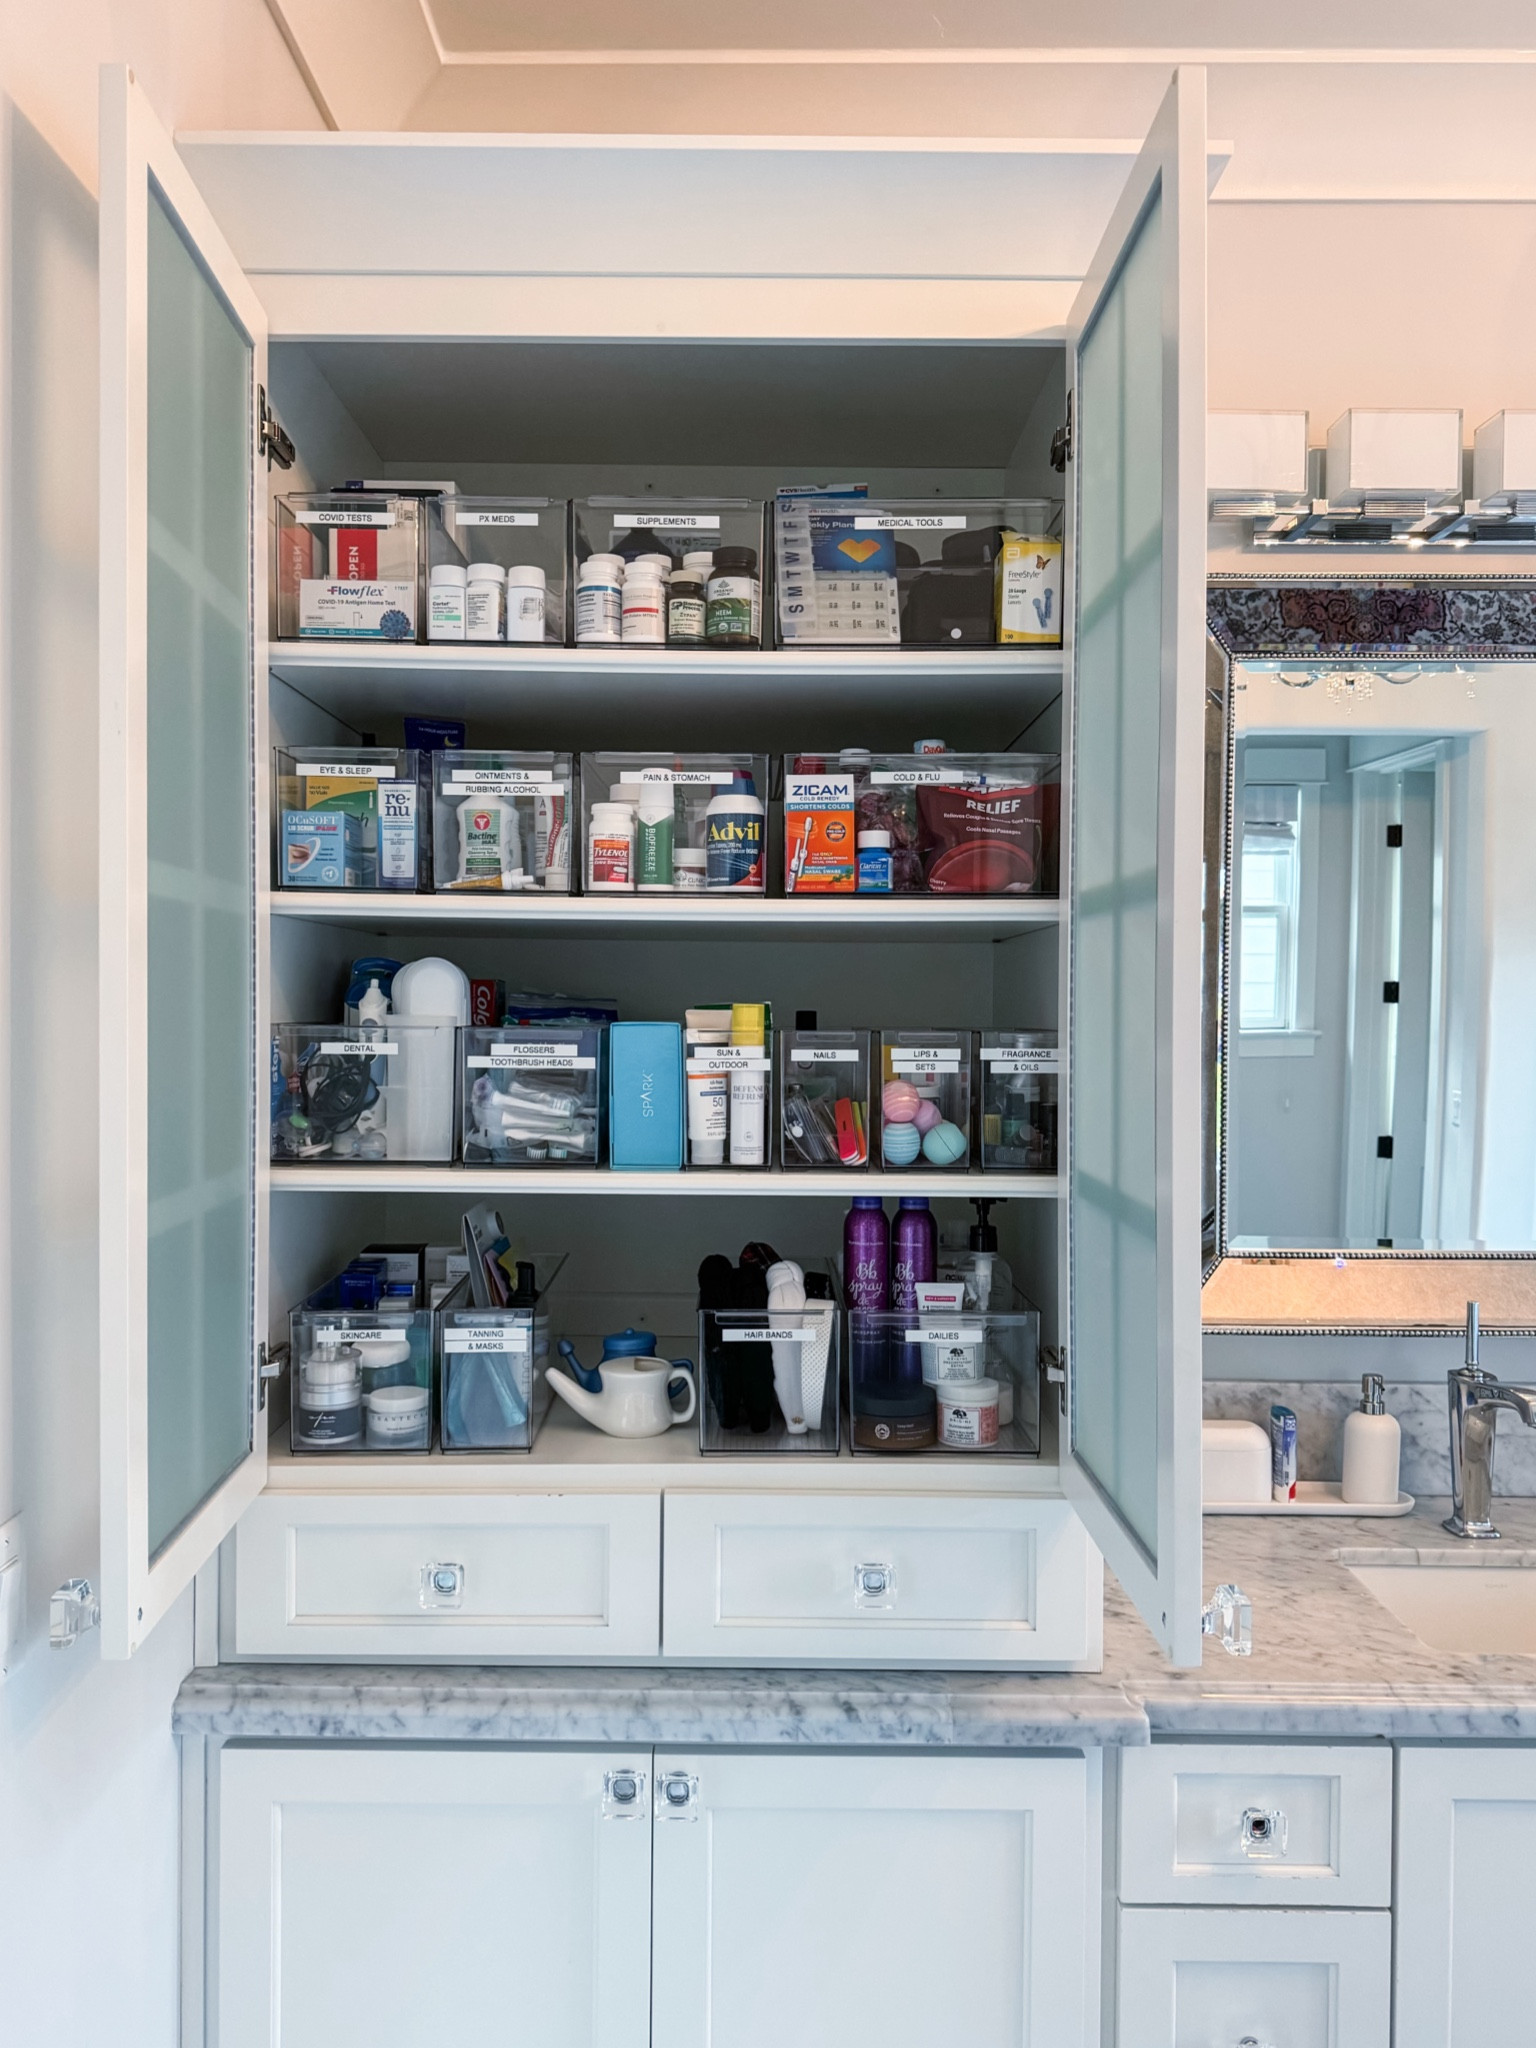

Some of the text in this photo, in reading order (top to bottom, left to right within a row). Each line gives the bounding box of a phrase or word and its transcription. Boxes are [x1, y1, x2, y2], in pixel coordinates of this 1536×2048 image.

[318, 513, 373, 523] COVID TESTS
[478, 515, 516, 523] PX MEDS
[636, 517, 697, 526] SUPPLEMENTS
[877, 518, 944, 527] MEDICAL TOOLS
[348, 546, 359, 580] OPEN
[1008, 570, 1040, 580] FreeStyle
[327, 585, 384, 599] Flowflex
[319, 766, 372, 775] EYE & SLEEP
[474, 772, 530, 780] OINTMENTS &
[670, 774, 710, 782] STOMACH
[893, 773, 940, 781] COLD & FLU
[465, 785, 541, 793] RUBBING ALCOHOL
[792, 785, 848, 796] ZICAM
[385, 805, 410, 817] nu
[966, 799, 1021, 815] RELIEF
[287, 815, 336, 825] OCuSOFT
[708, 821, 760, 842] Advil
[467, 832, 497, 841] Bactine
[594, 848, 628, 857] TYLENOL
[648, 828, 656, 872] BIOFREEZE
[490, 1058, 545, 1066] TOOTHBRUSH
[643, 1072, 654, 1118] SPARK
[712, 1096, 723, 1107] 50
[848, 1279, 884, 1300] spray
[340, 1331, 382, 1340] SKINCARE
[467, 1330, 504, 1338] TANNING
[744, 1331, 793, 1339] HAIR BANDS
[928, 1331, 959, 1340] DAILIES
[467, 1342, 504, 1350] & MASKS
